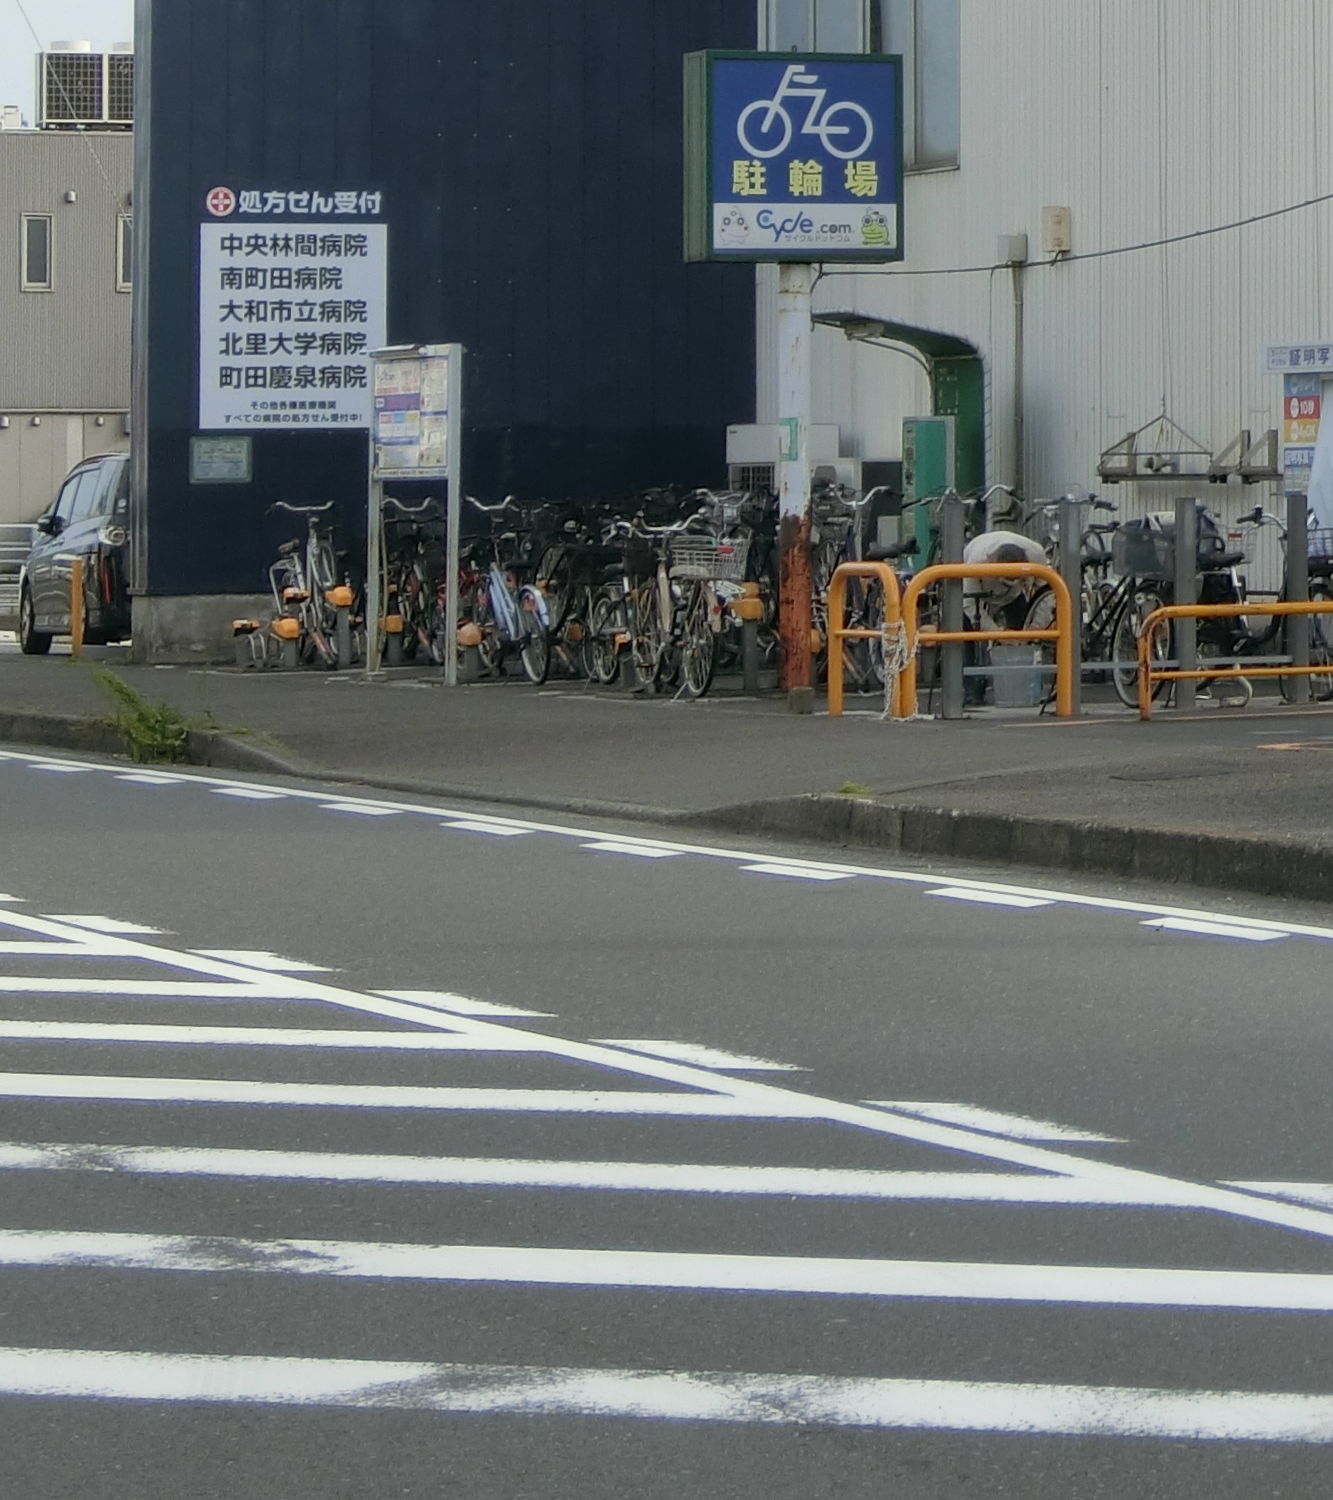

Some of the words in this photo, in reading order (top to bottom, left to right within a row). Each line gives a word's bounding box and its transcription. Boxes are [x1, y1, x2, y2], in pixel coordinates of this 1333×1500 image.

[732, 159, 878, 197] 駐輪場
[239, 190, 381, 214] 処方せん受付
[219, 233, 368, 257] 中央林間病院
[219, 267, 342, 290] 南町田病院
[219, 299, 368, 323] 大和市立病院
[219, 332, 367, 356] 北里大学病院
[219, 366, 367, 389] 町田慶泉病院
